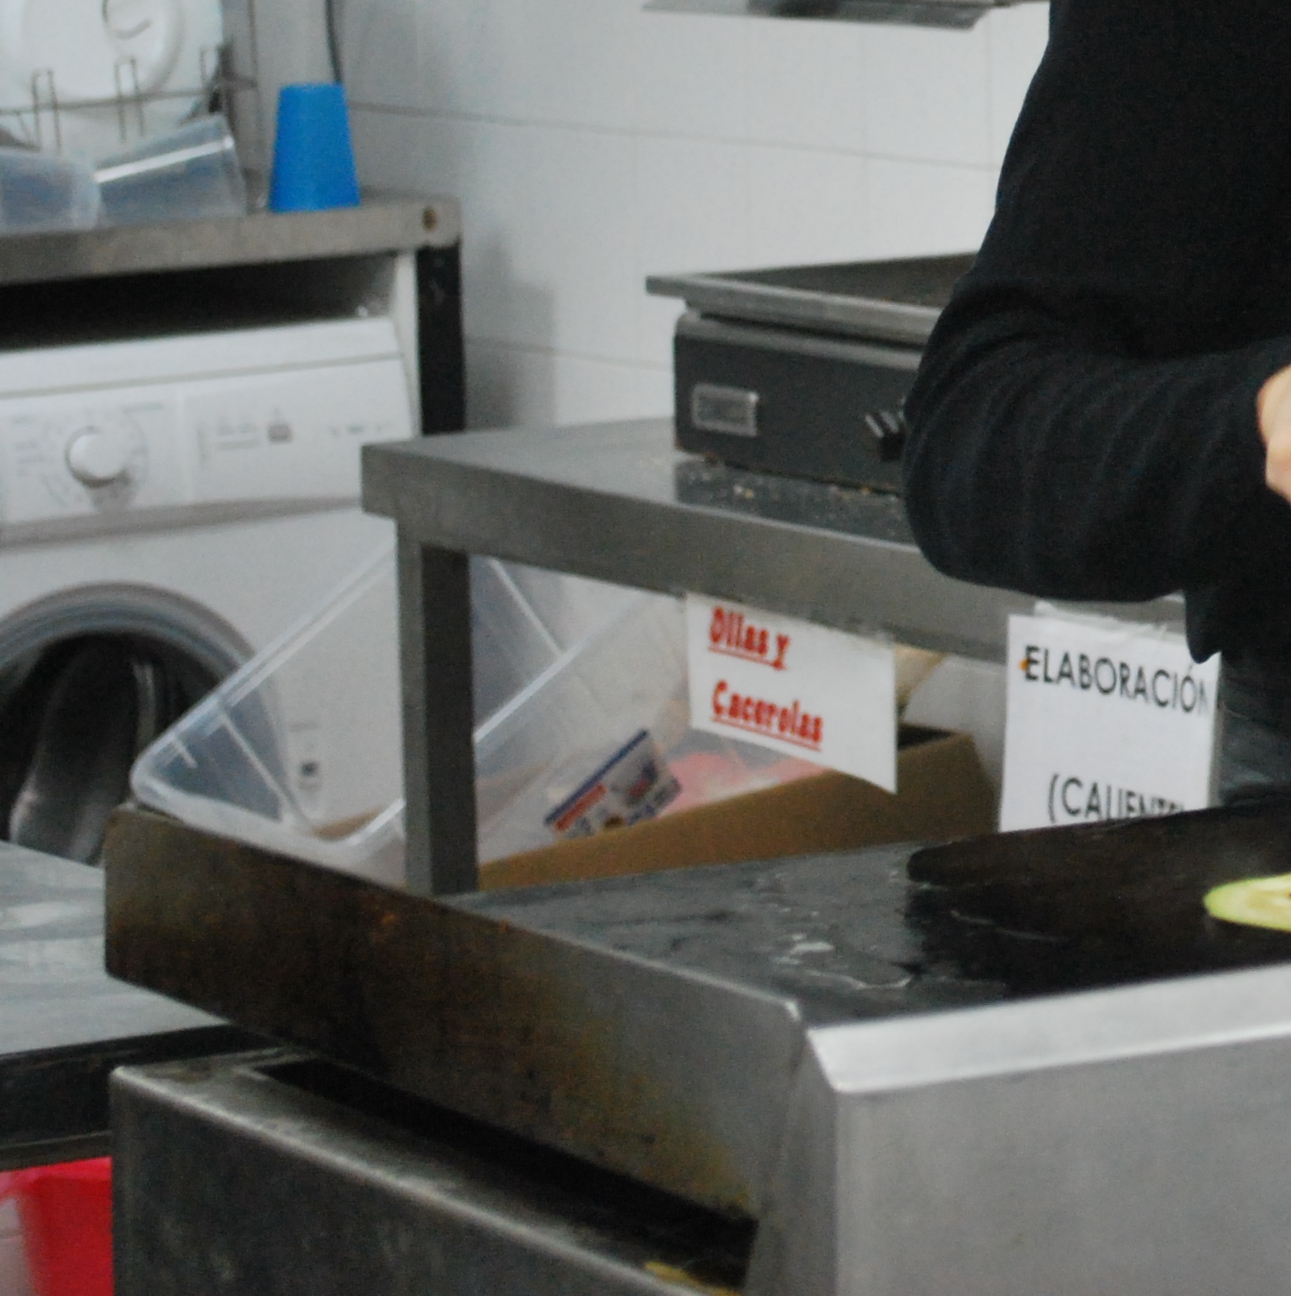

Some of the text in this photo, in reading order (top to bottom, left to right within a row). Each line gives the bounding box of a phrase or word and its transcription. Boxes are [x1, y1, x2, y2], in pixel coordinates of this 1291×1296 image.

[709, 605, 770, 655] Ollas
[712, 679, 824, 743] Cacerolas
[1048, 773, 1184, 823] (CALIENT
